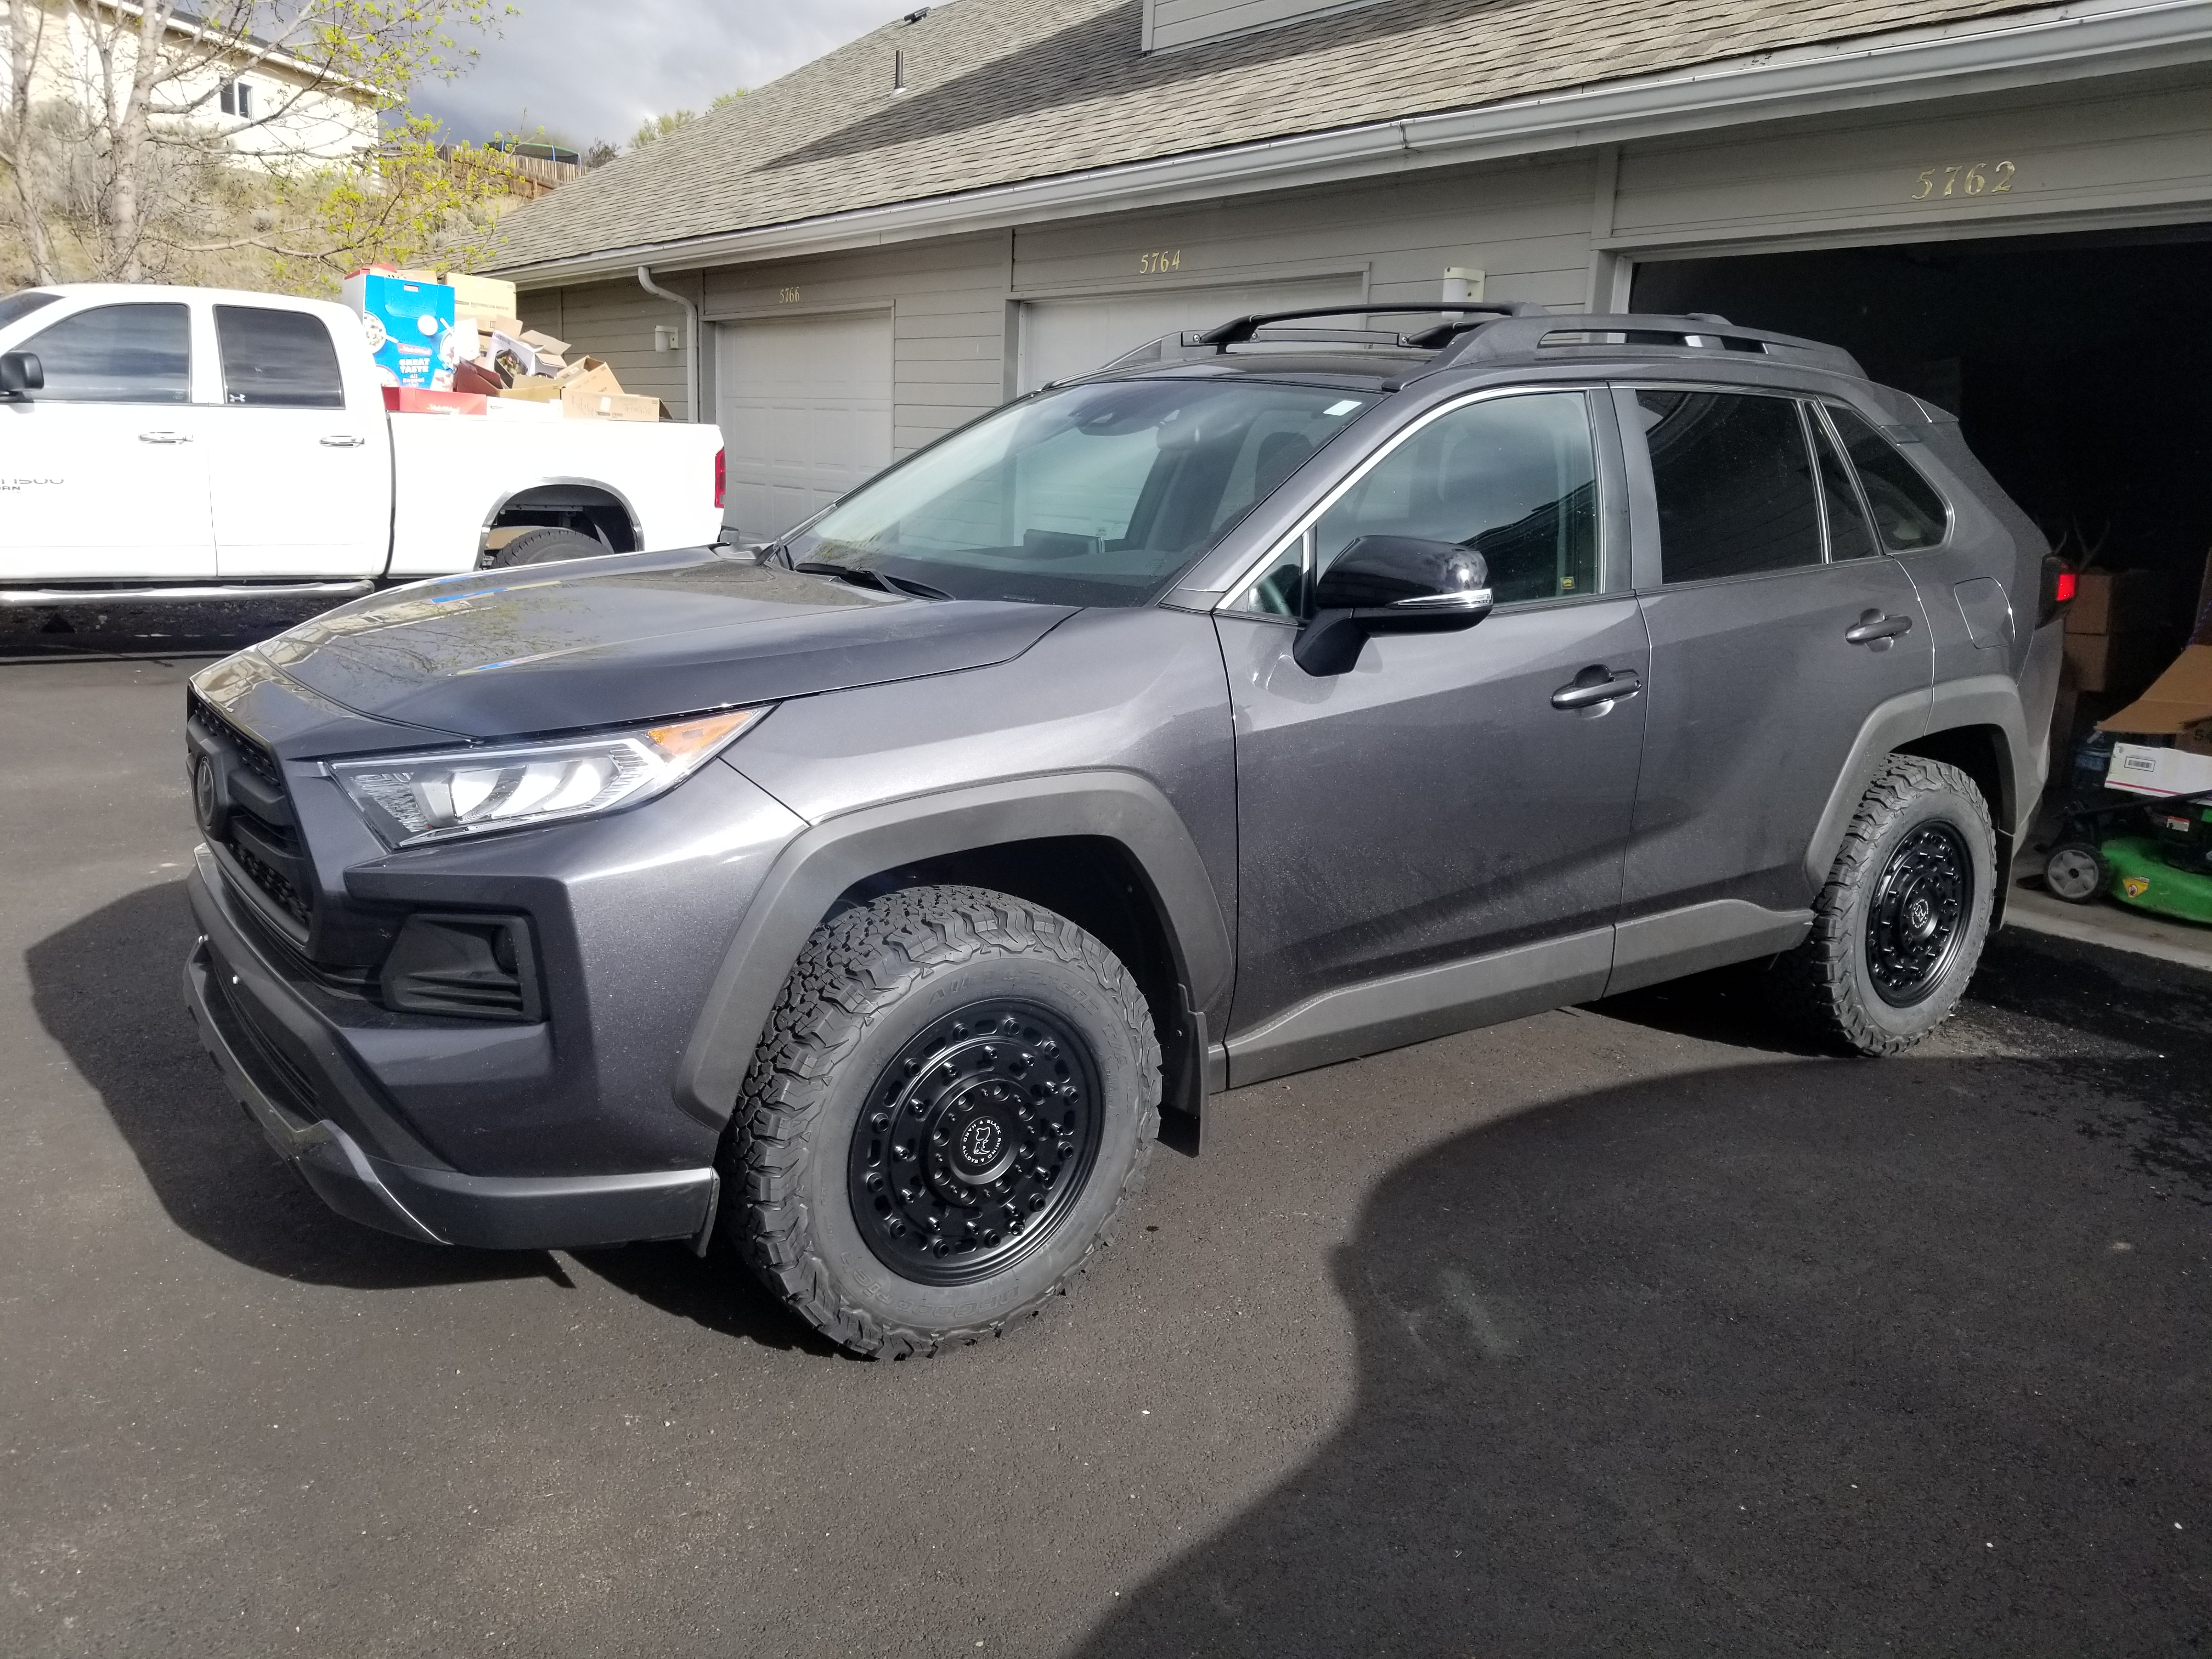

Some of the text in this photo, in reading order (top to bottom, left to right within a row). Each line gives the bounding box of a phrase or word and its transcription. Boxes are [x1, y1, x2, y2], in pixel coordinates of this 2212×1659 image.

[1911, 161, 2015, 200] 5762
[1139, 249, 1181, 274] 5764
[779, 286, 800, 303] 5766
[399, 358, 430, 366] GREAT
[399, 365, 429, 374] TASTE
[962, 1124, 979, 1164] HARD ALLOYS
[986, 1119, 1002, 1159] BLACK RHINO
